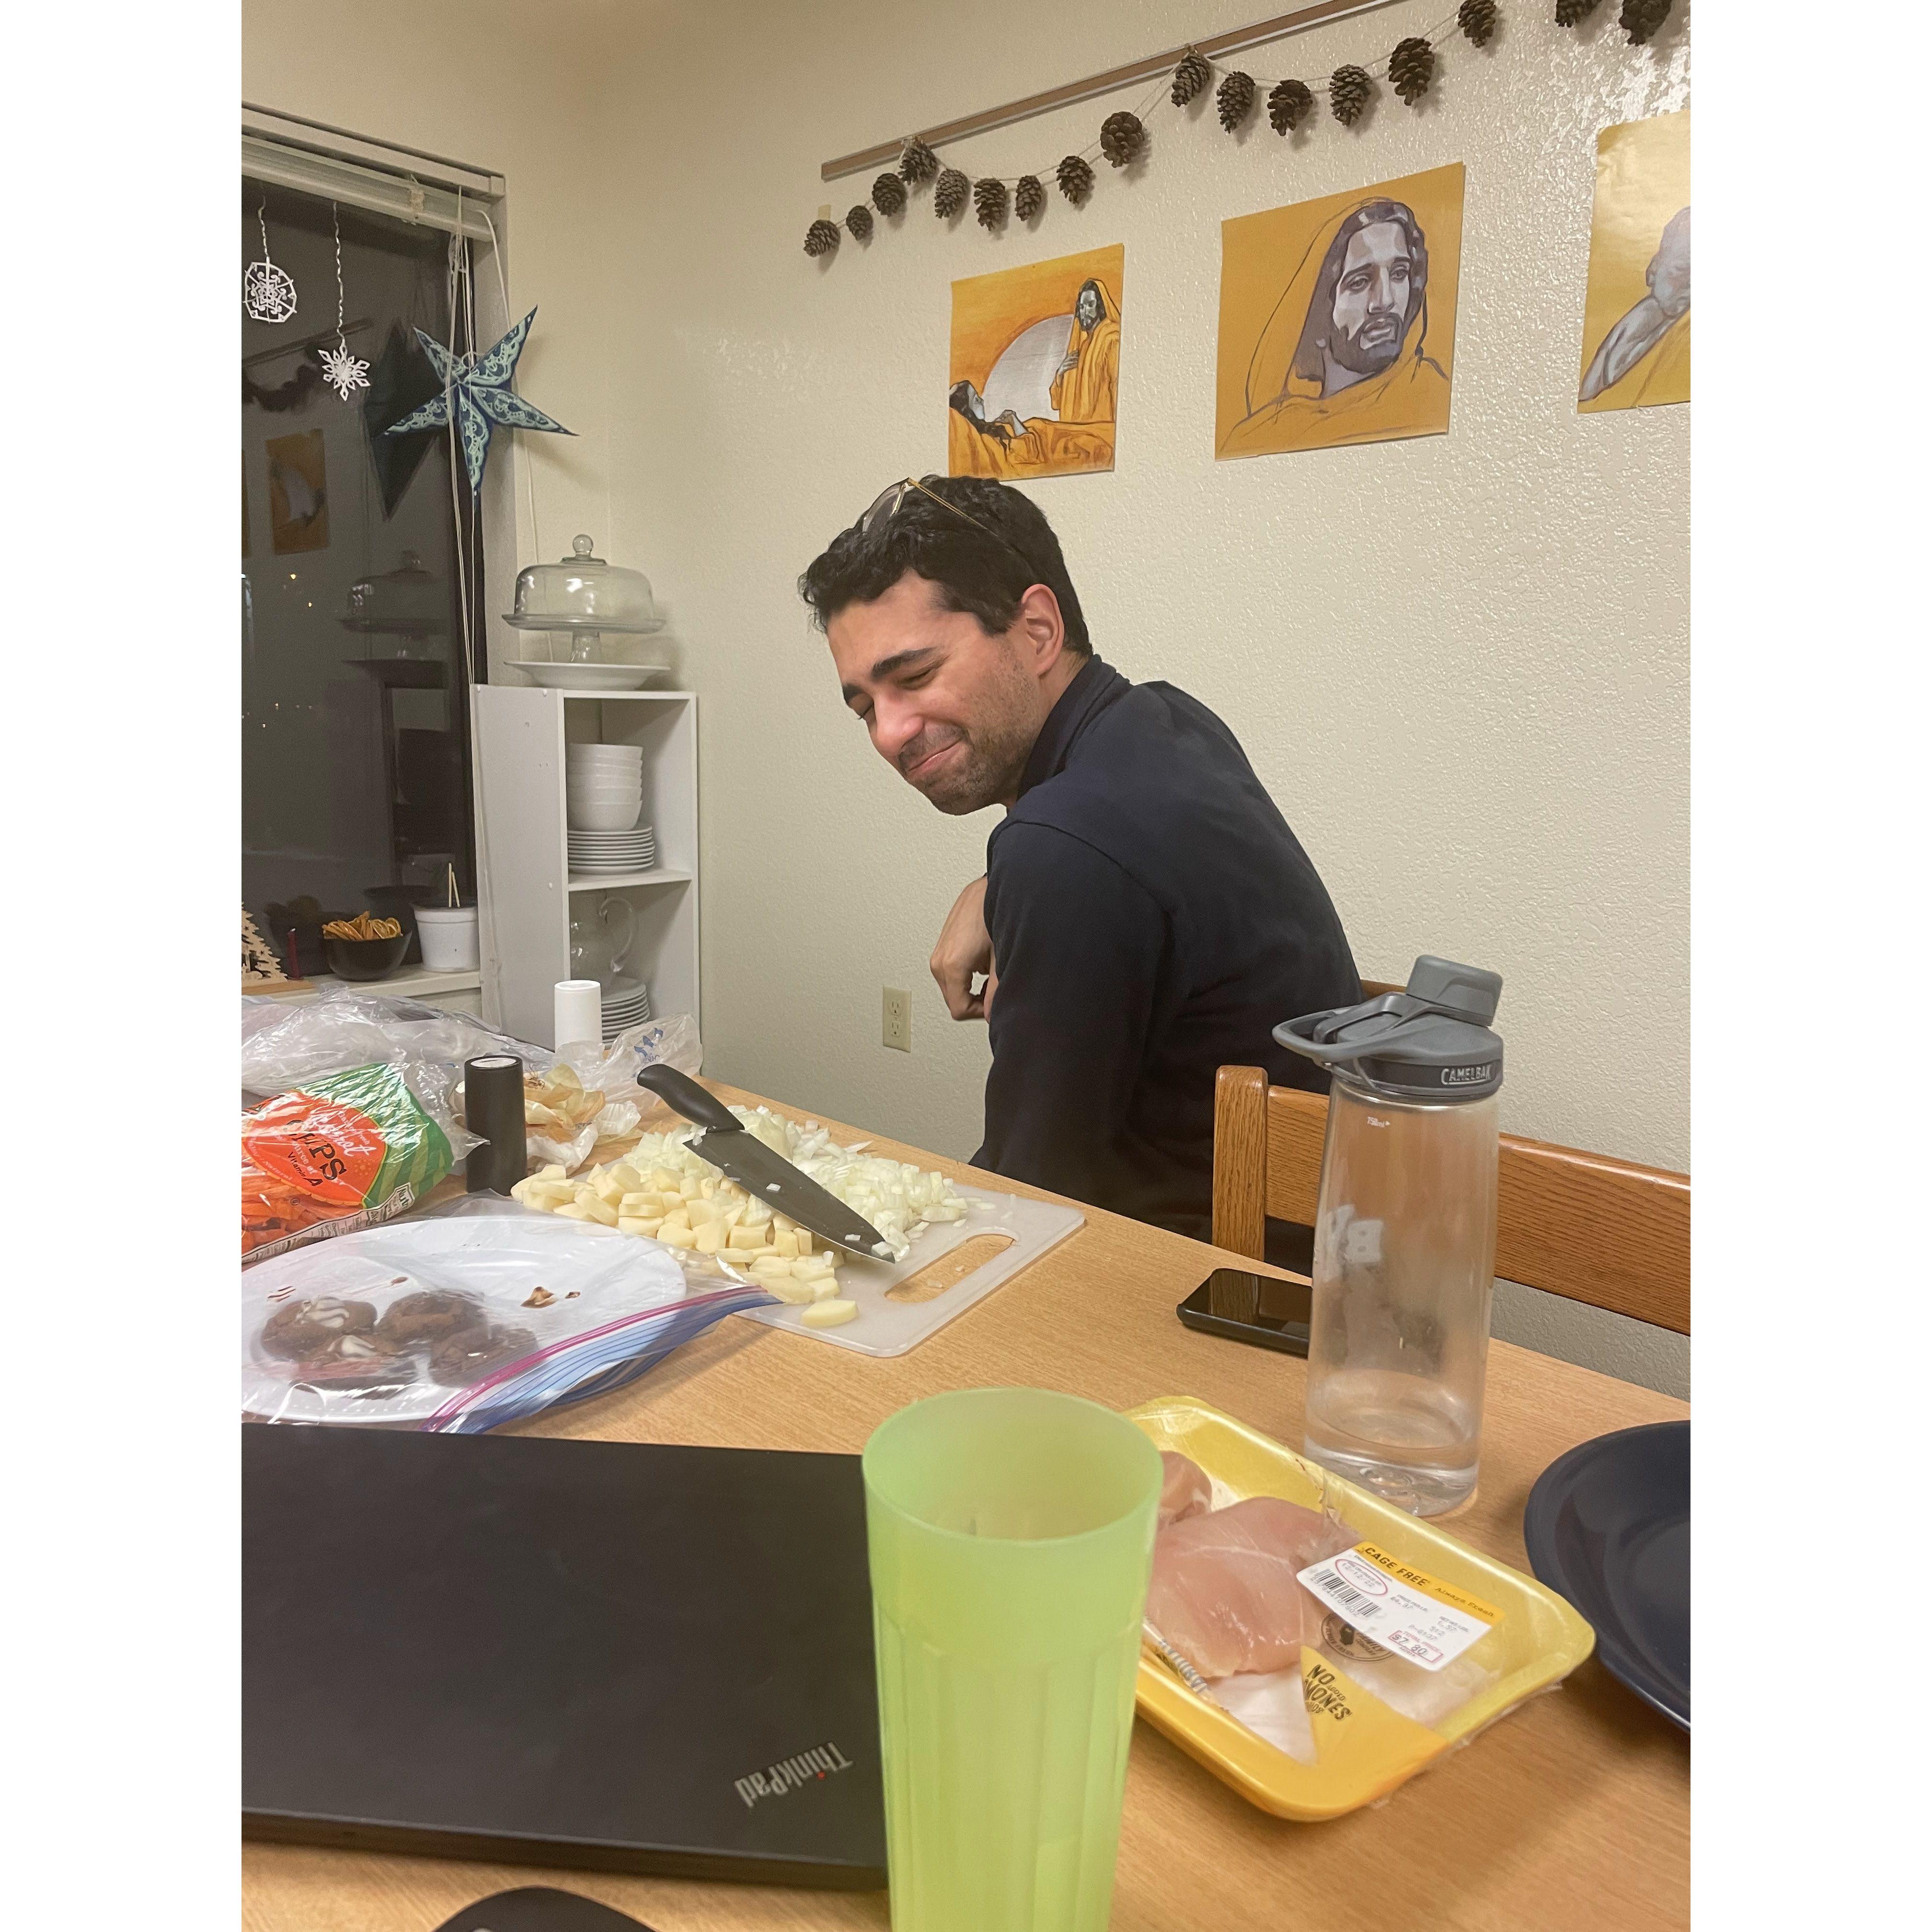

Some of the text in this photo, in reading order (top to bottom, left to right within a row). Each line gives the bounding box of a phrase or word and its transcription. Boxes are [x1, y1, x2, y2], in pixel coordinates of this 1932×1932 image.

[1441, 1064, 1491, 1085] CAMELBAK
[1365, 1547, 1397, 1569] CAGE
[1435, 1587, 1466, 1603] Always
[1468, 1602, 1494, 1618] Fresh
[1403, 1631, 1421, 1643] TOTAL
[1307, 1664, 1335, 1685] NO
[735, 1742, 853, 1808] ThinkPad
